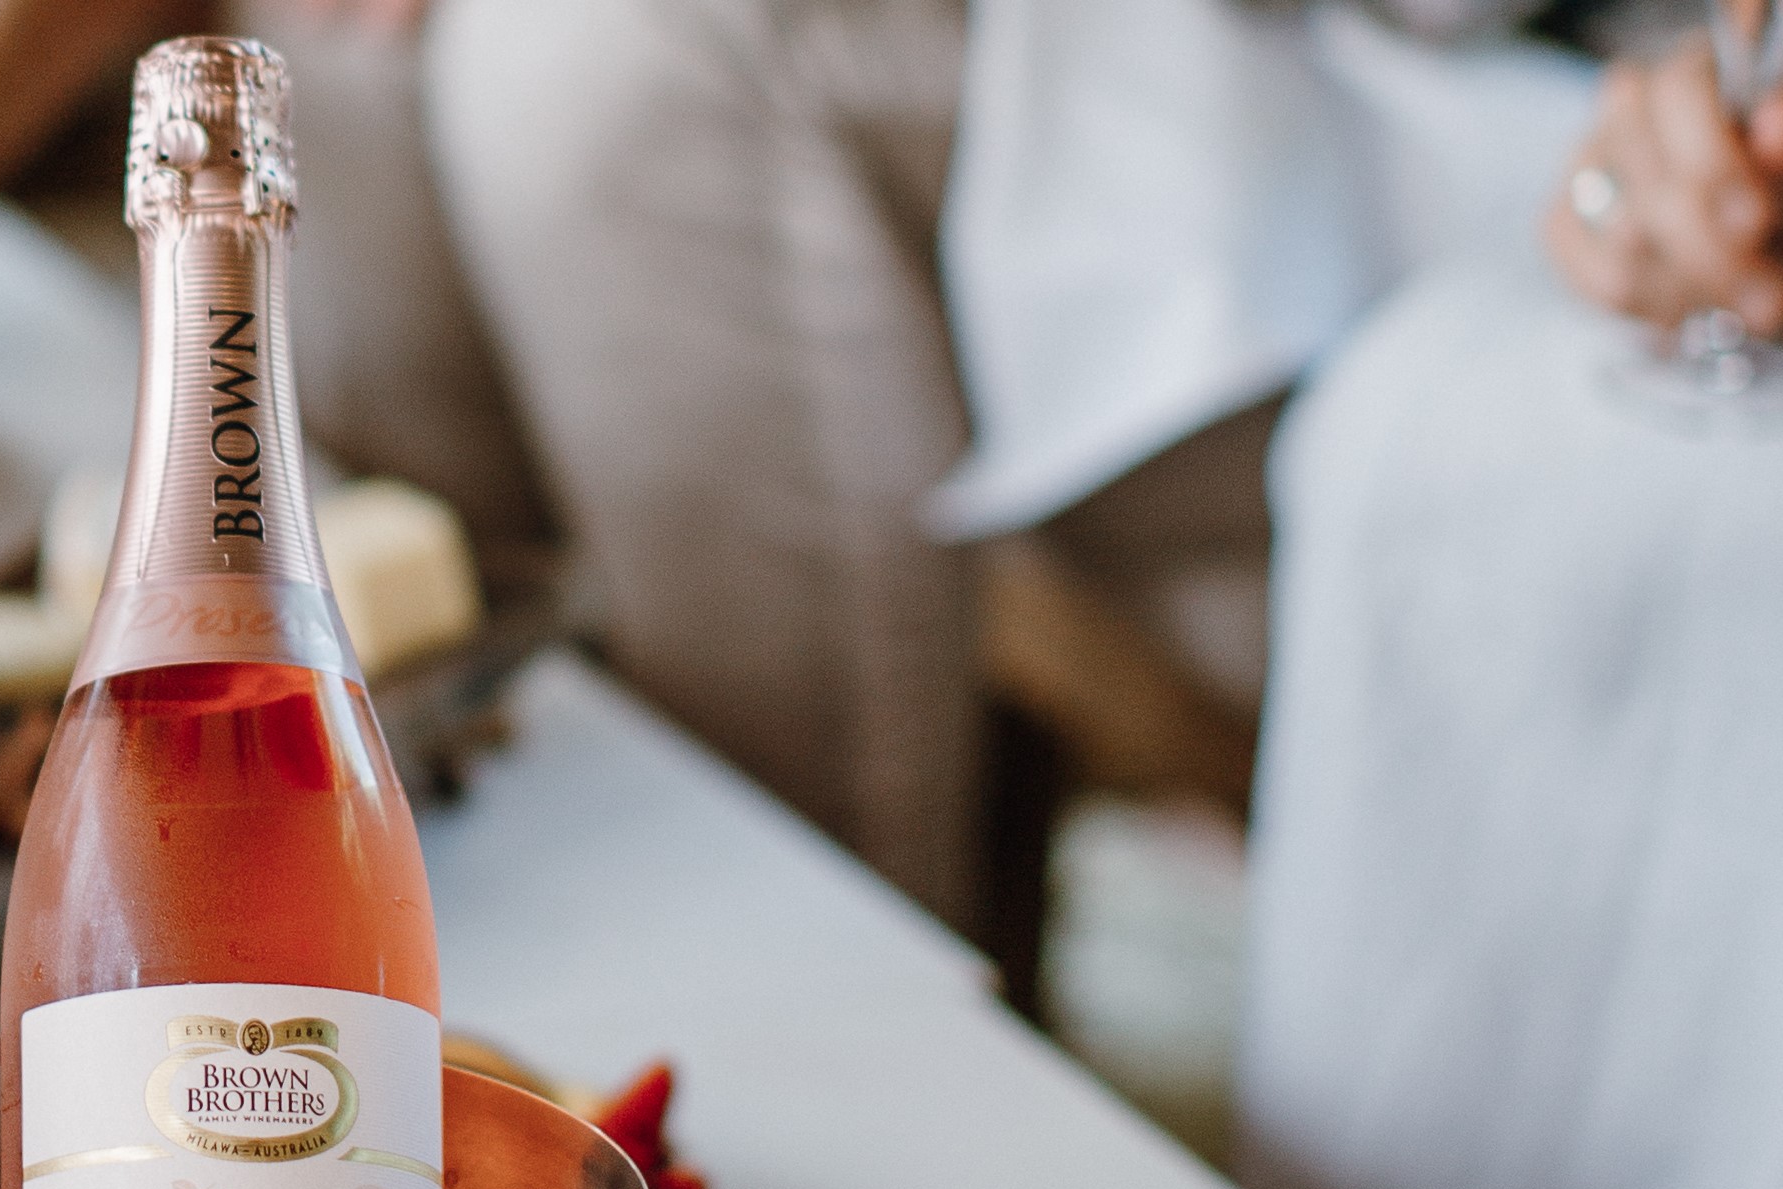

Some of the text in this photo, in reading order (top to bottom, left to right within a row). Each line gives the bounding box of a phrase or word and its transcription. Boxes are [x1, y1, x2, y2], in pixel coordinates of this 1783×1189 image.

[208, 305, 265, 543] BROWN
[285, 1026, 323, 1039] 1889
[203, 1064, 309, 1090] BROWN
[186, 1088, 326, 1116] BROTHERS
[198, 1115, 314, 1125] FAMILY WINEMAKERS
